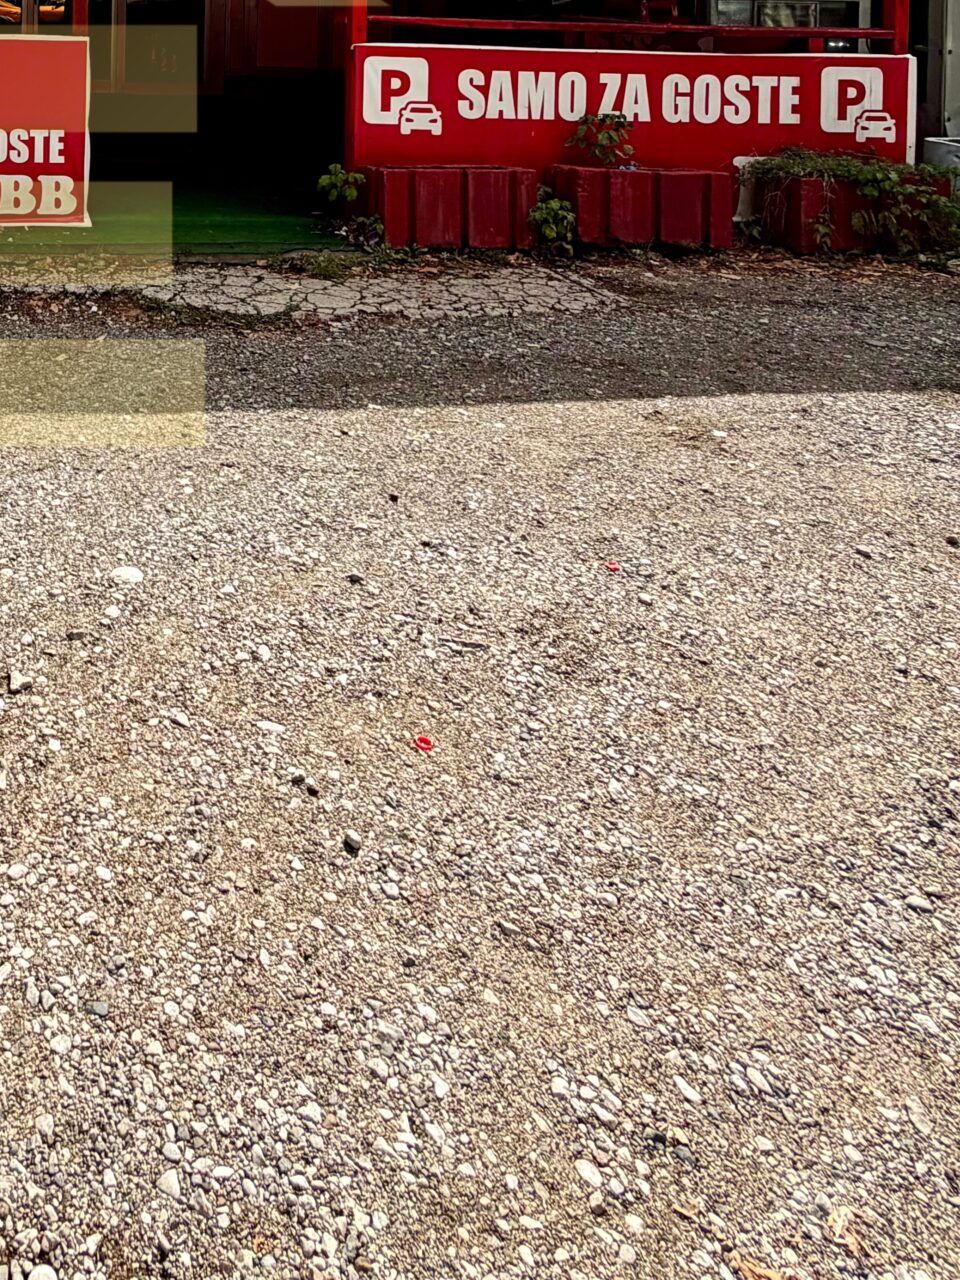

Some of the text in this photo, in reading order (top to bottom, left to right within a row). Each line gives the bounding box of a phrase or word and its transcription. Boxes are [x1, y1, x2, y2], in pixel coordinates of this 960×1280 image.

[457, 69, 587, 122] SAMO
[598, 73, 652, 122] ZA
[661, 73, 801, 125] GOSTE
